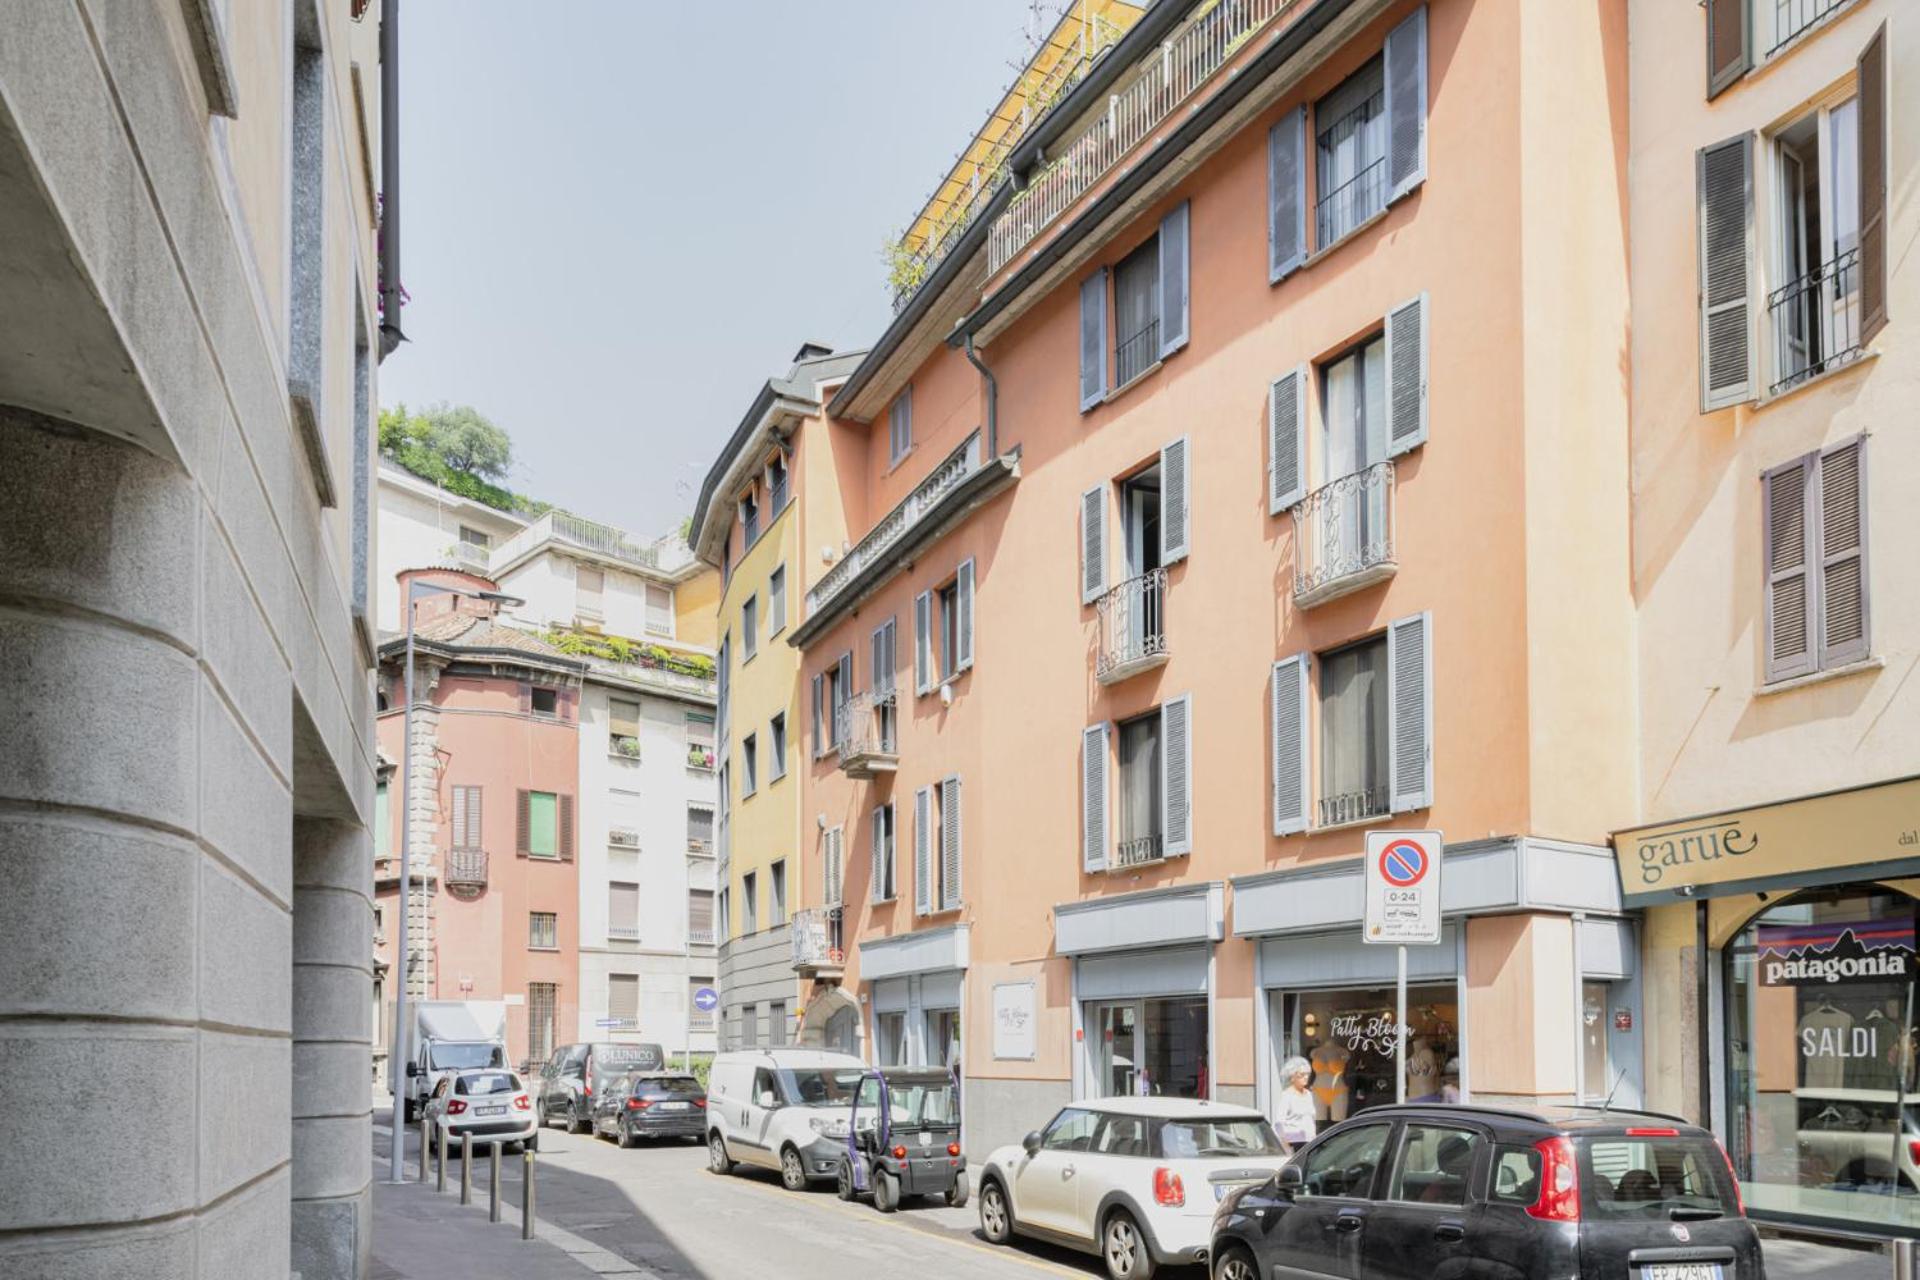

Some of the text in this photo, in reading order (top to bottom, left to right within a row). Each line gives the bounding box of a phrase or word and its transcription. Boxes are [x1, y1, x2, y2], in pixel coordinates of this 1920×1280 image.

[1639, 829, 1758, 883] garue
[1390, 892, 1415, 901] 0-24
[1766, 951, 1906, 984] patagonia
[1331, 1013, 1362, 1050] Patty
[1802, 1027, 1876, 1057] SALDI
